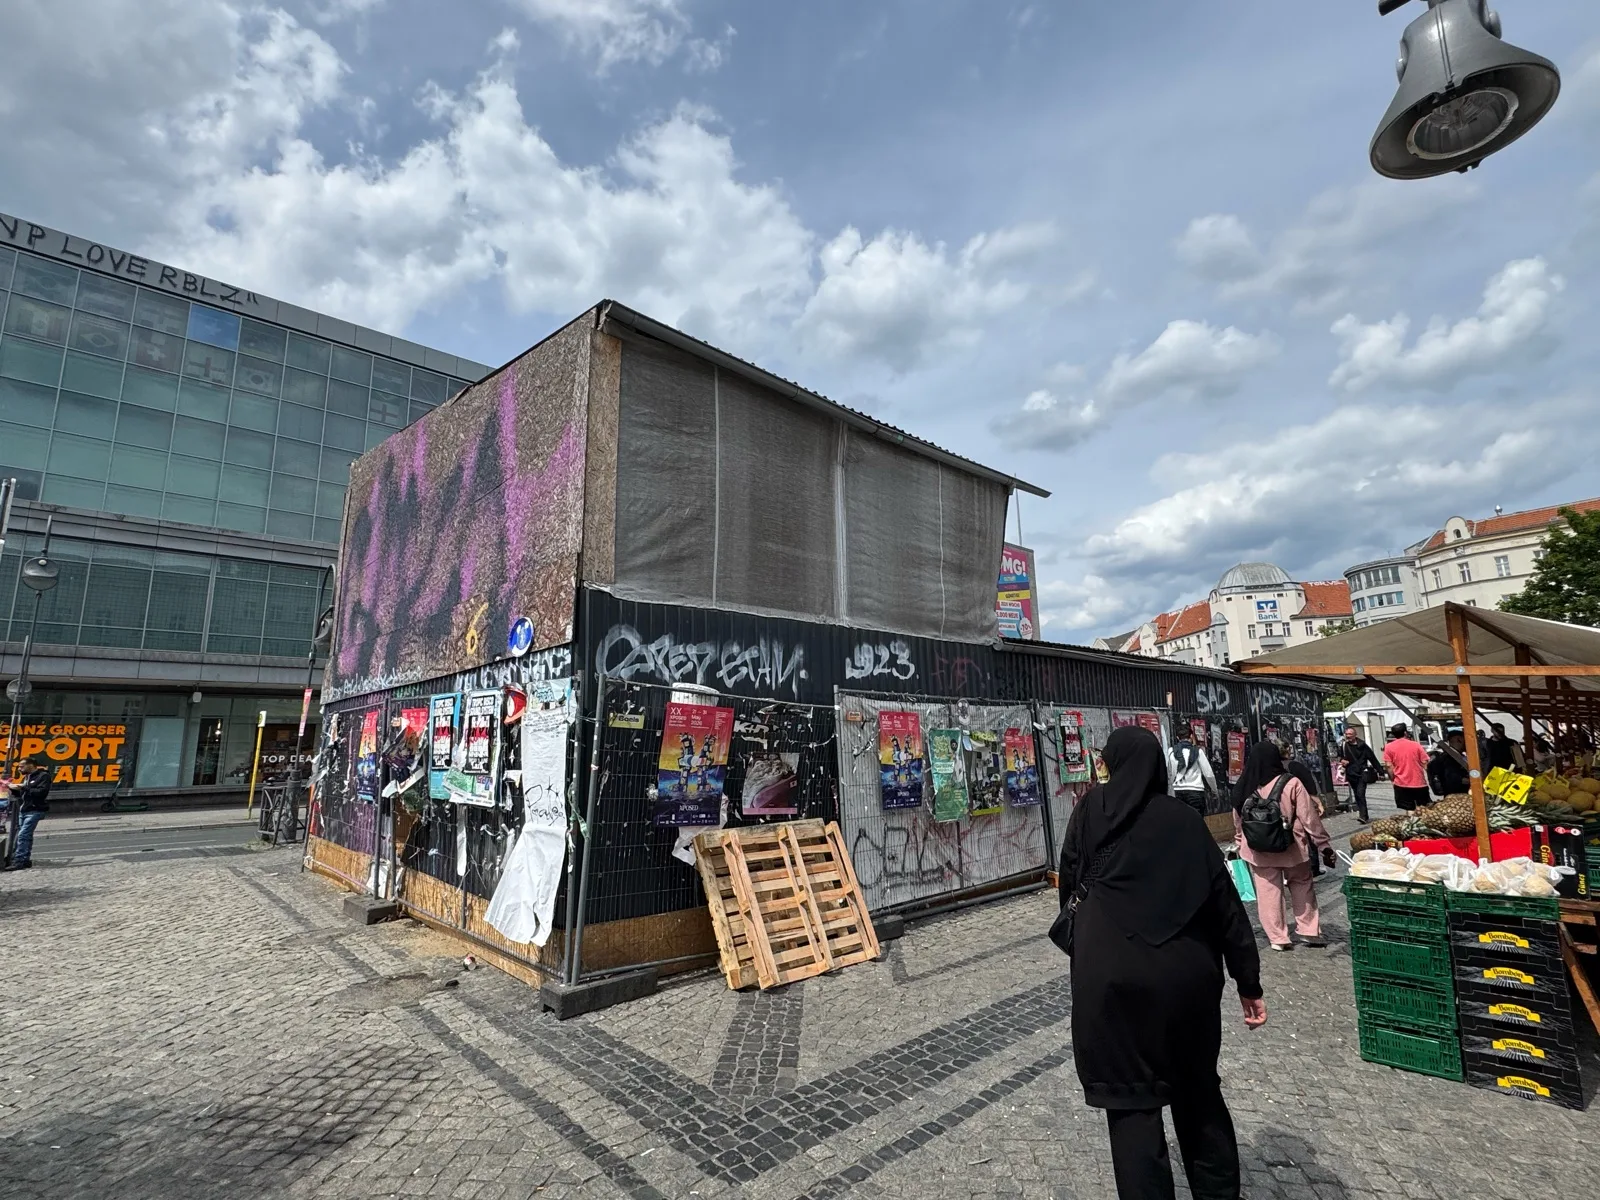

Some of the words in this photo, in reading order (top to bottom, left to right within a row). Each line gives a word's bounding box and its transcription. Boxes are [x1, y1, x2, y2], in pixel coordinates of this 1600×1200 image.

[61, 236, 149, 277] LOVE
[1258, 613, 1279, 621] Bank
[49, 724, 126, 736] GROSSER
[0, 737, 125, 761] SPORT
[262, 755, 285, 763] TOP
[290, 755, 316, 763] DEA
[52, 764, 122, 783] ALLE
